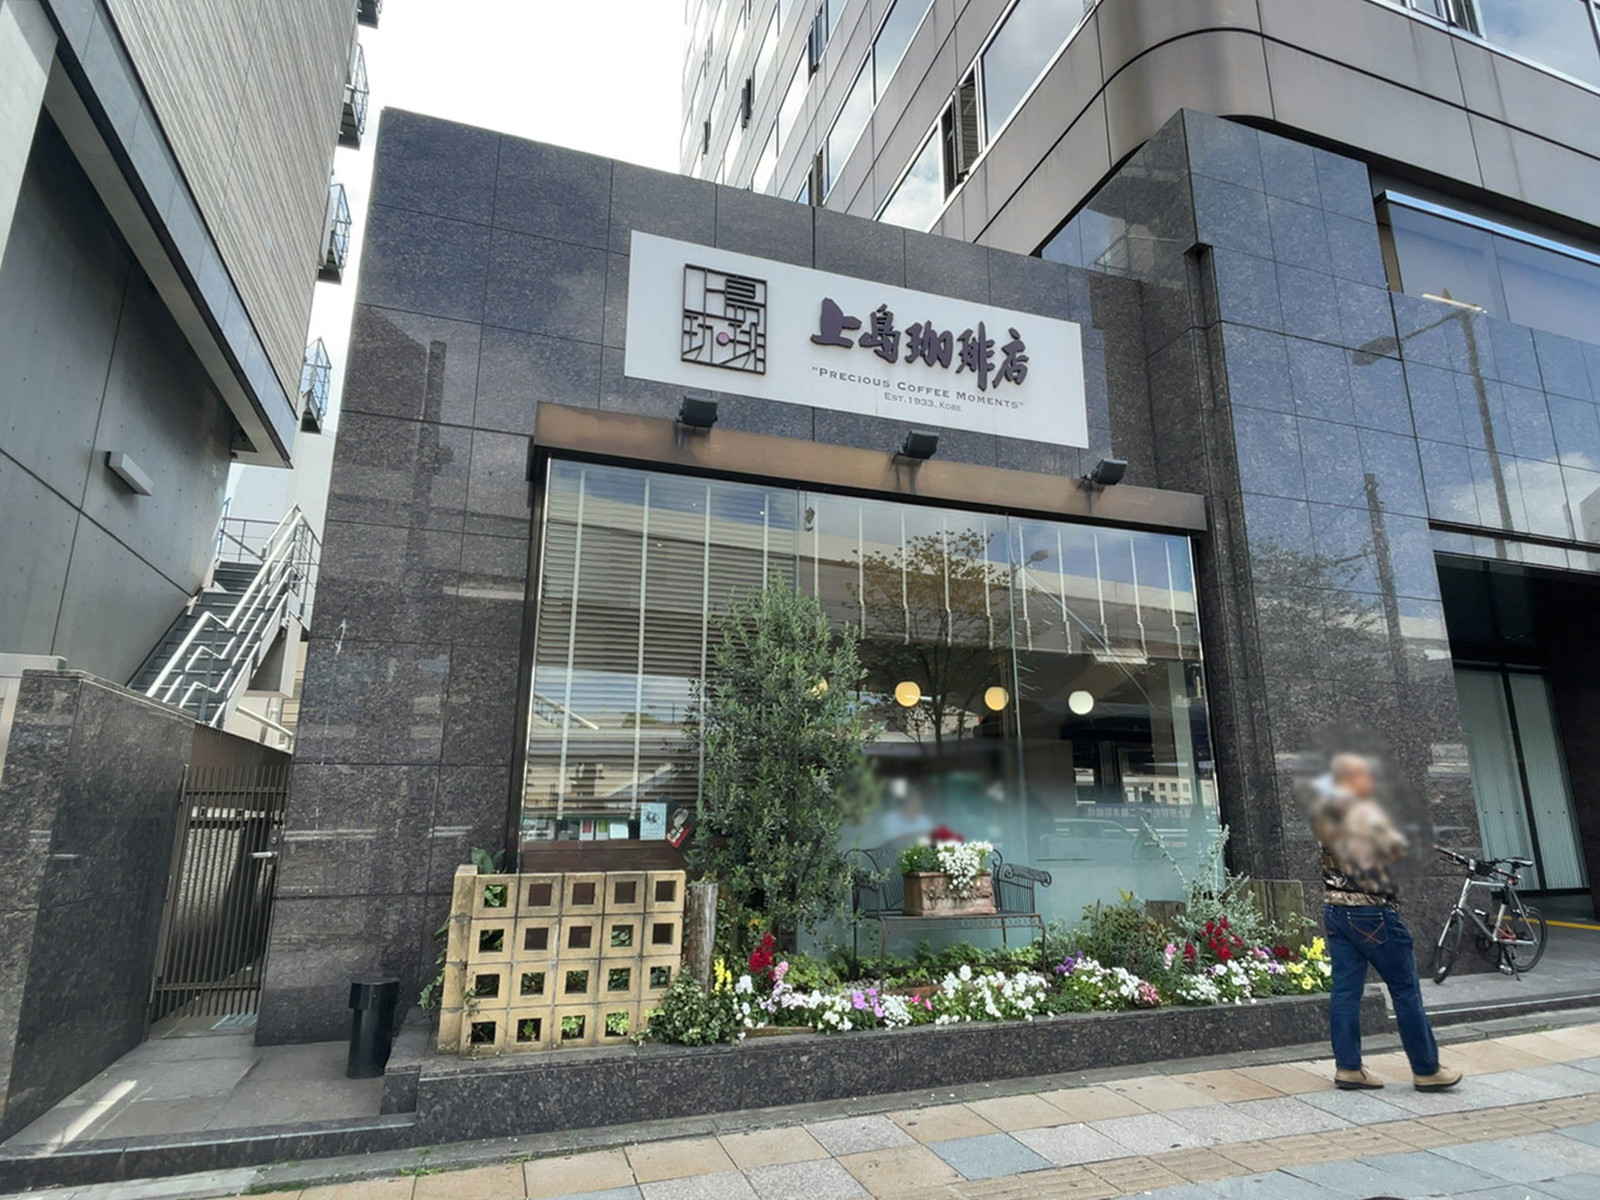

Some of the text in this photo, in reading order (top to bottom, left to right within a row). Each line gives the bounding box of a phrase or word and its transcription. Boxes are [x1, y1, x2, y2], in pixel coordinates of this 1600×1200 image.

[810, 297, 1029, 391] 上島珈琲店
[897, 381, 950, 398] COFFEE
